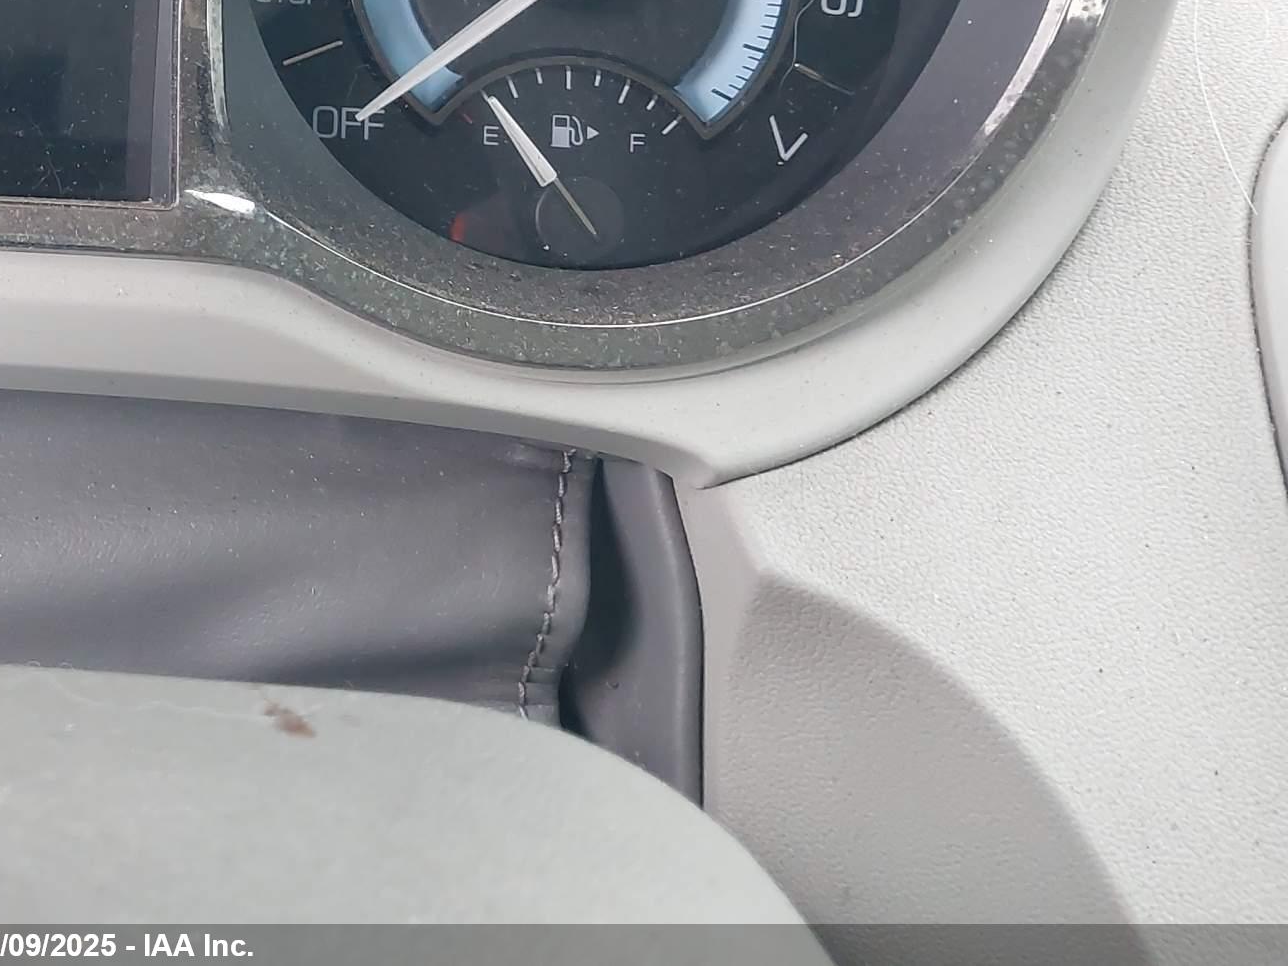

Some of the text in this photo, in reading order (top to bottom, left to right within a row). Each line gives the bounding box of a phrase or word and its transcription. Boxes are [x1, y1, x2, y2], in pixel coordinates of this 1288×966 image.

[312, 105, 386, 141] OFF
[483, 125, 500, 146] E
[630, 133, 646, 153] F
[769, 115, 808, 162] 7
